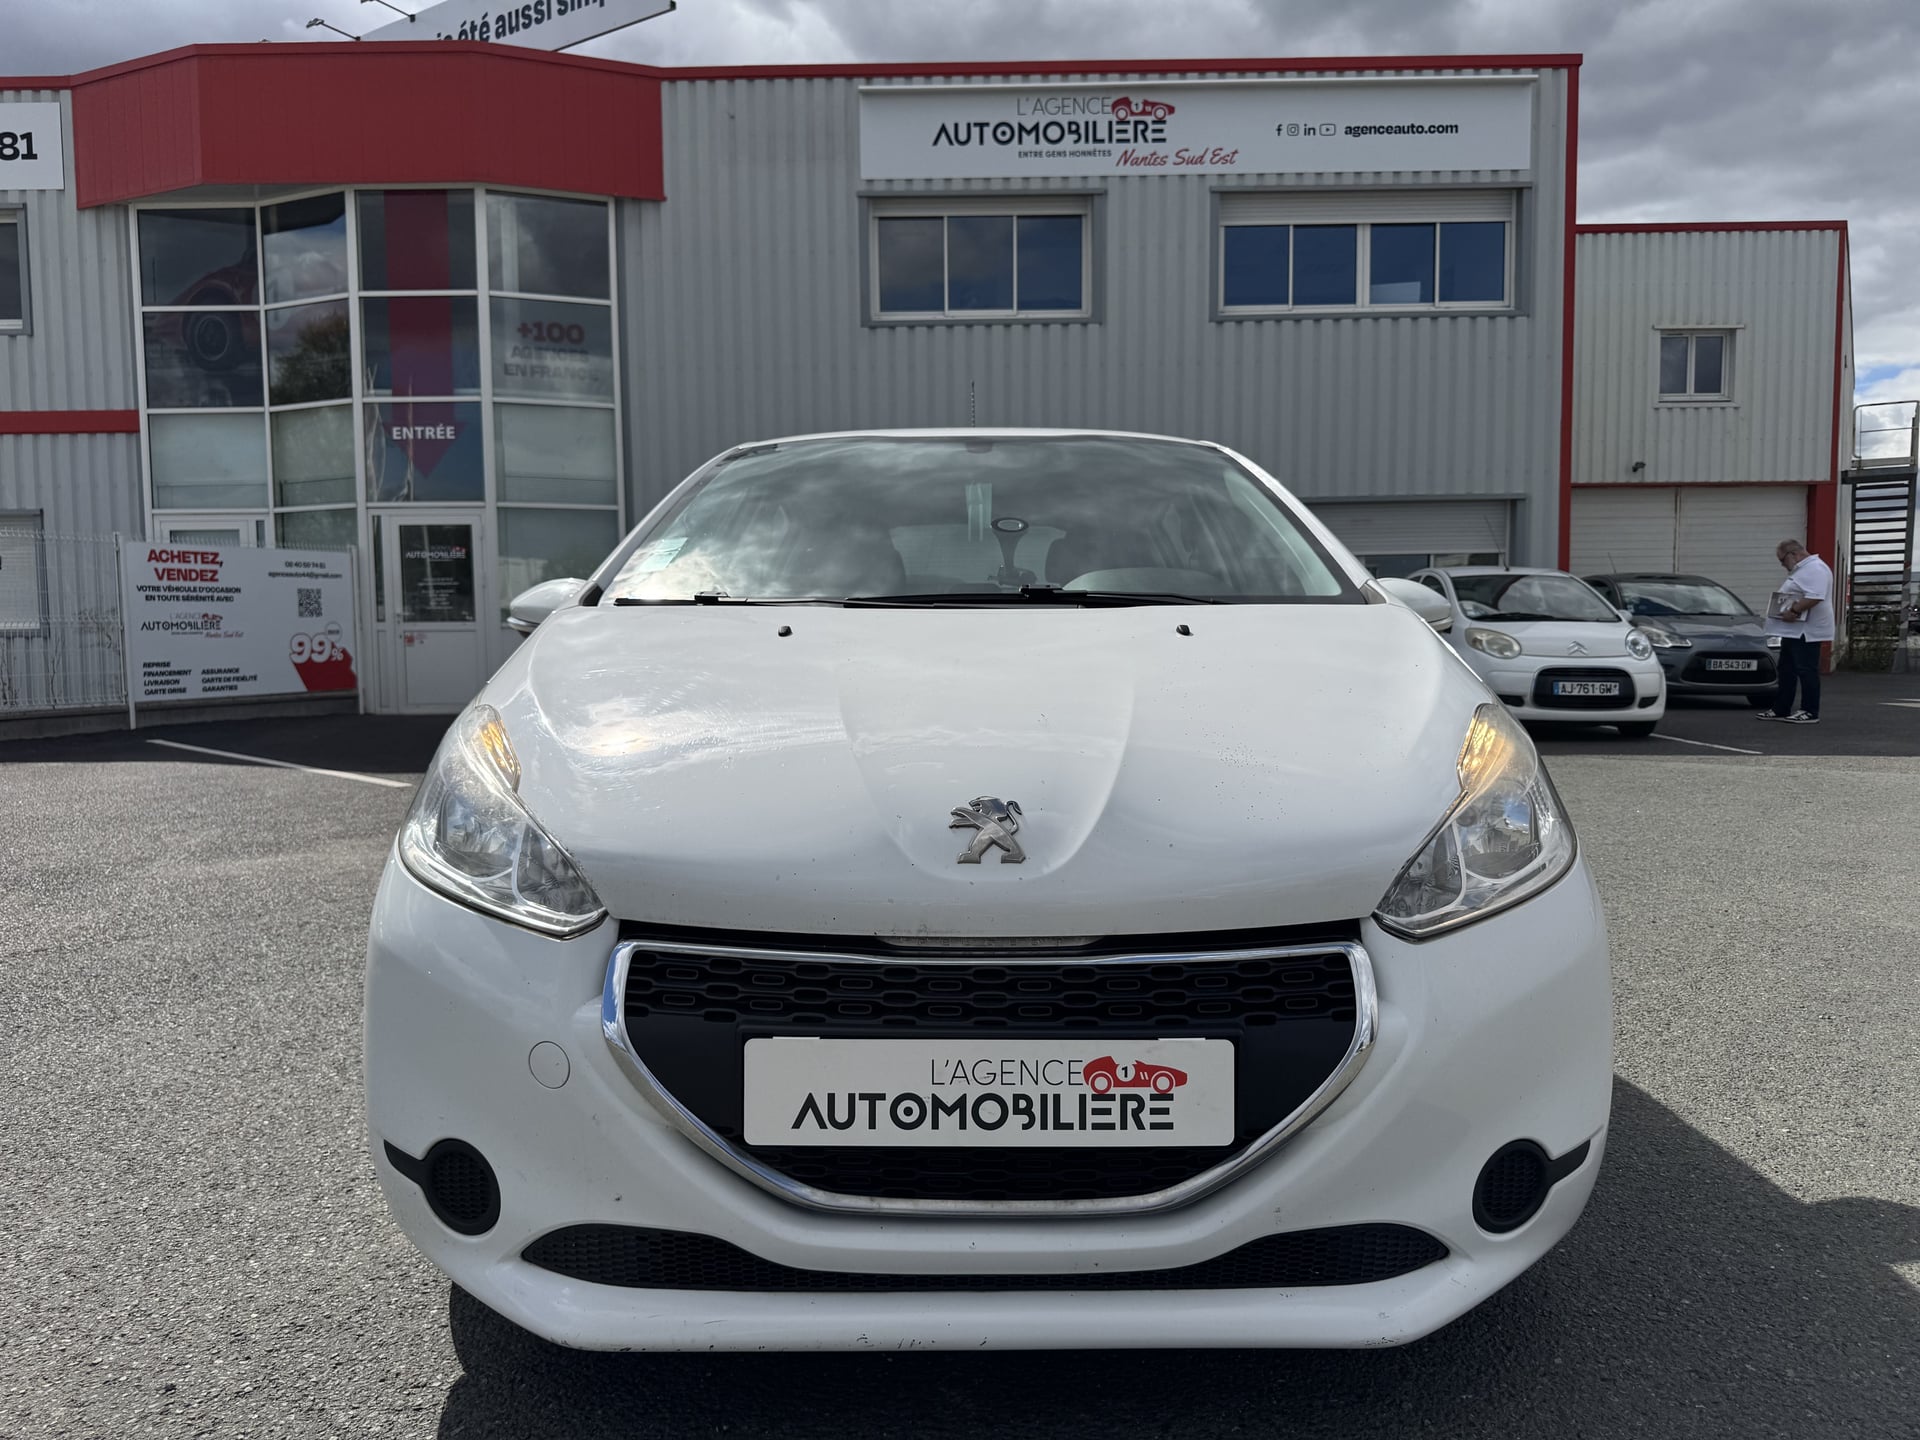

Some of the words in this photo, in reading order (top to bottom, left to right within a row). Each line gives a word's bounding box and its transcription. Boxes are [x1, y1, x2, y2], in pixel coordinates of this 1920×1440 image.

[1016, 96, 1112, 116] L'AGENCE
[1344, 123, 1459, 137] agenceauto.com
[0, 131, 38, 161] 81
[1018, 150, 1044, 159] ENTRE
[1045, 150, 1067, 158] GENS
[1069, 148, 1112, 158] HONNÊTES
[1116, 148, 1168, 167] Nantes
[1172, 147, 1209, 166] Sud
[1209, 147, 1240, 165] Est
[517, 321, 585, 345] +100
[392, 423, 456, 440] ENTRÉE
[147, 549, 224, 567] ACHETEZ,
[154, 568, 219, 582] VENDEZ
[136, 585, 161, 593] VOTRE
[163, 584, 198, 593] VÉHICULE
[199, 586, 241, 594] D'OCCASION
[181, 594, 215, 602] SÉRÉNITÉ
[143, 669, 192, 677] FINANCEMENT
[201, 667, 240, 675] ASSURANCE
[144, 678, 181, 687] LIVRAISON
[201, 676, 222, 684] CARTE
[202, 685, 238, 693] GARANTIES
[931, 1059, 1084, 1086] L'AGENCE
